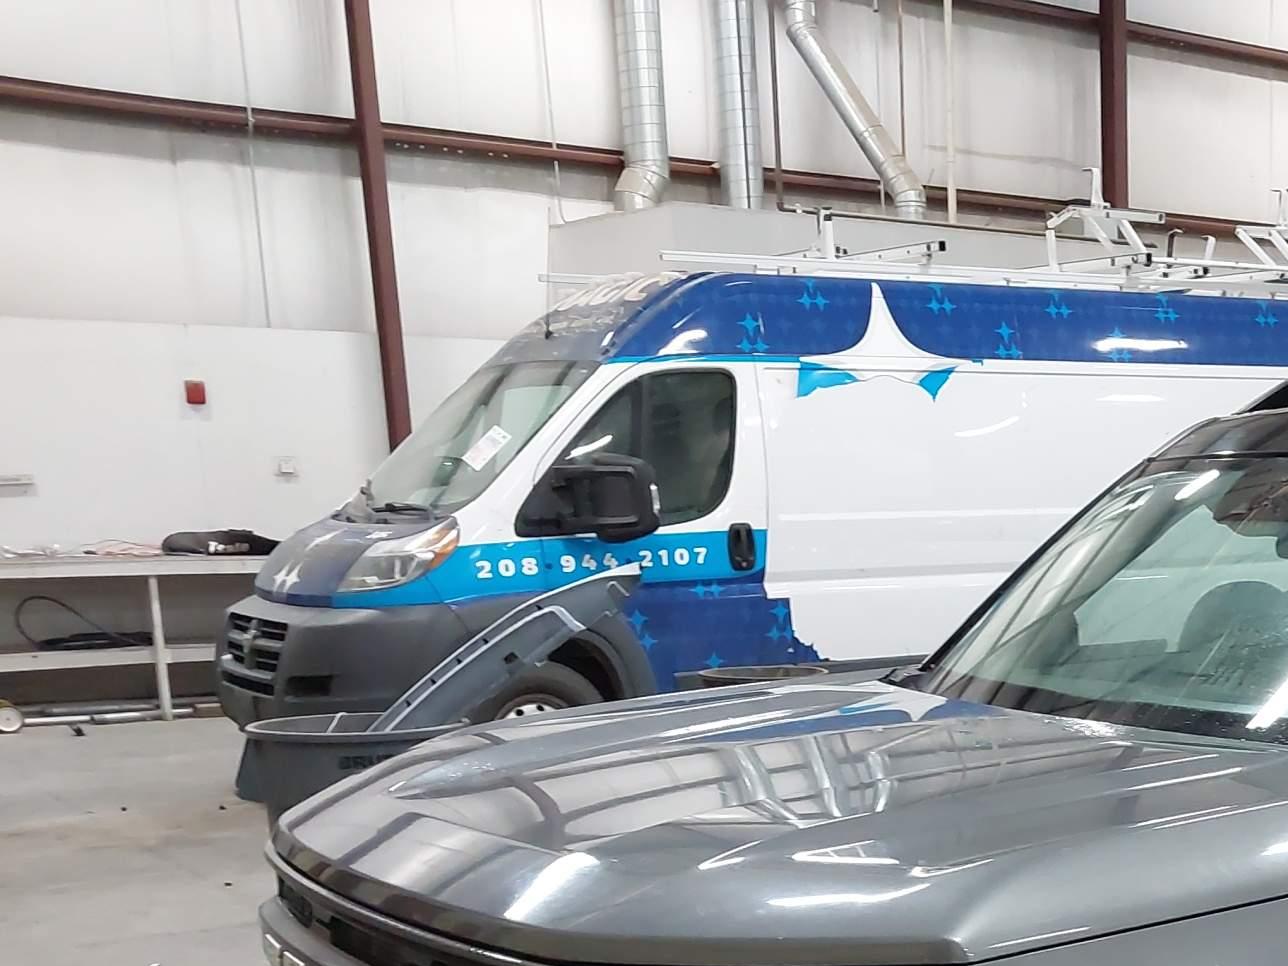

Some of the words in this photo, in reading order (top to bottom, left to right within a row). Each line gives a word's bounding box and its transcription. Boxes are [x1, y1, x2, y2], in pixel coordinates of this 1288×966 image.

[474, 557, 539, 579] 208
[559, 553, 619, 573] 944
[637, 547, 708, 567] 2107
